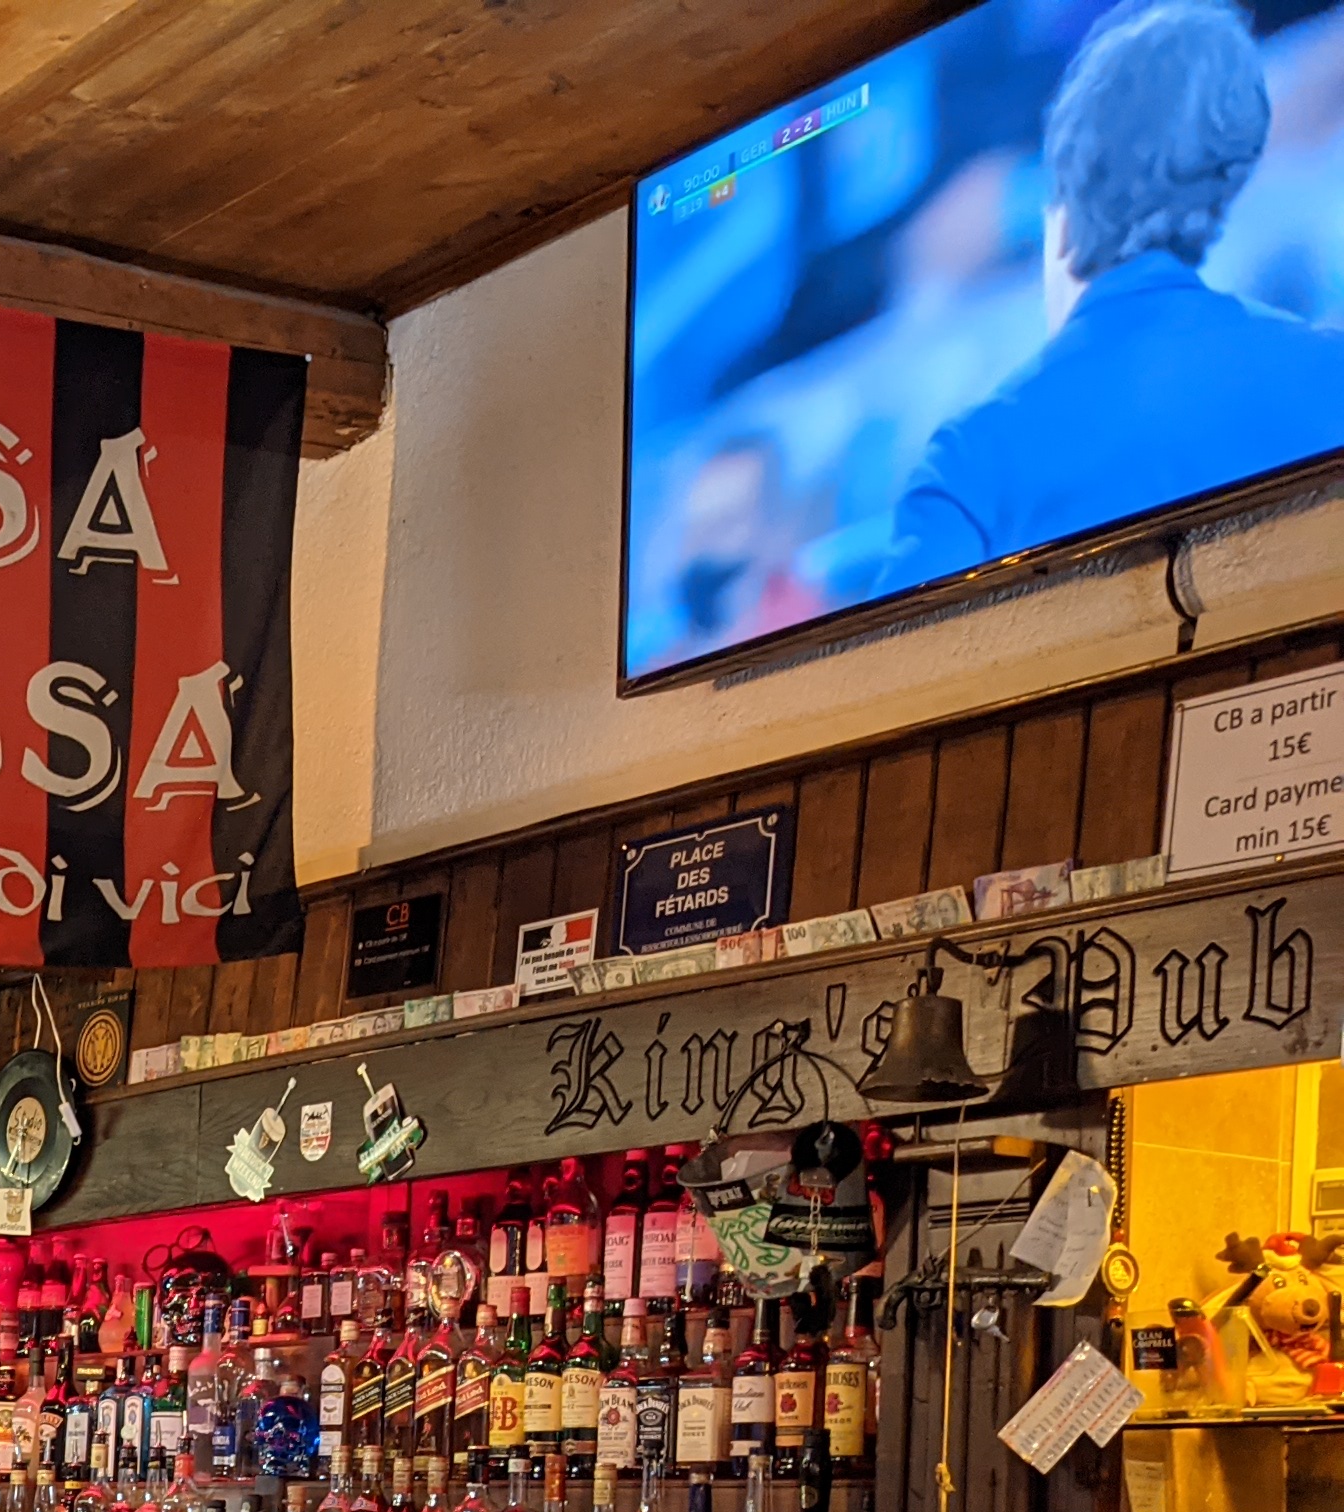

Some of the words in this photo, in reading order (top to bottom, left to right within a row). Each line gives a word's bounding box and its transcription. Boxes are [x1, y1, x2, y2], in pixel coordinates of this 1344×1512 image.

[684, 165, 720, 193] 90:00
[741, 140, 767, 163] GER
[827, 95, 856, 121] HUN
[1215, 707, 1244, 733] CB
[1250, 708, 1263, 725] a
[1270, 687, 1338, 727] partir
[1268, 732, 1313, 762] 15€
[1205, 787, 1258, 818] Card
[1236, 827, 1280, 852] min
[1288, 813, 1332, 844] 15€
[669, 841, 726, 869] PLACE
[93, 851, 255, 924] vici
[676, 867, 710, 890] DES
[654, 886, 730, 919] FÉTARDS
[664, 920, 704, 937] COMMUNE
[786, 926, 807, 941] 100
[1137, 1331, 1162, 1341] CLAN
